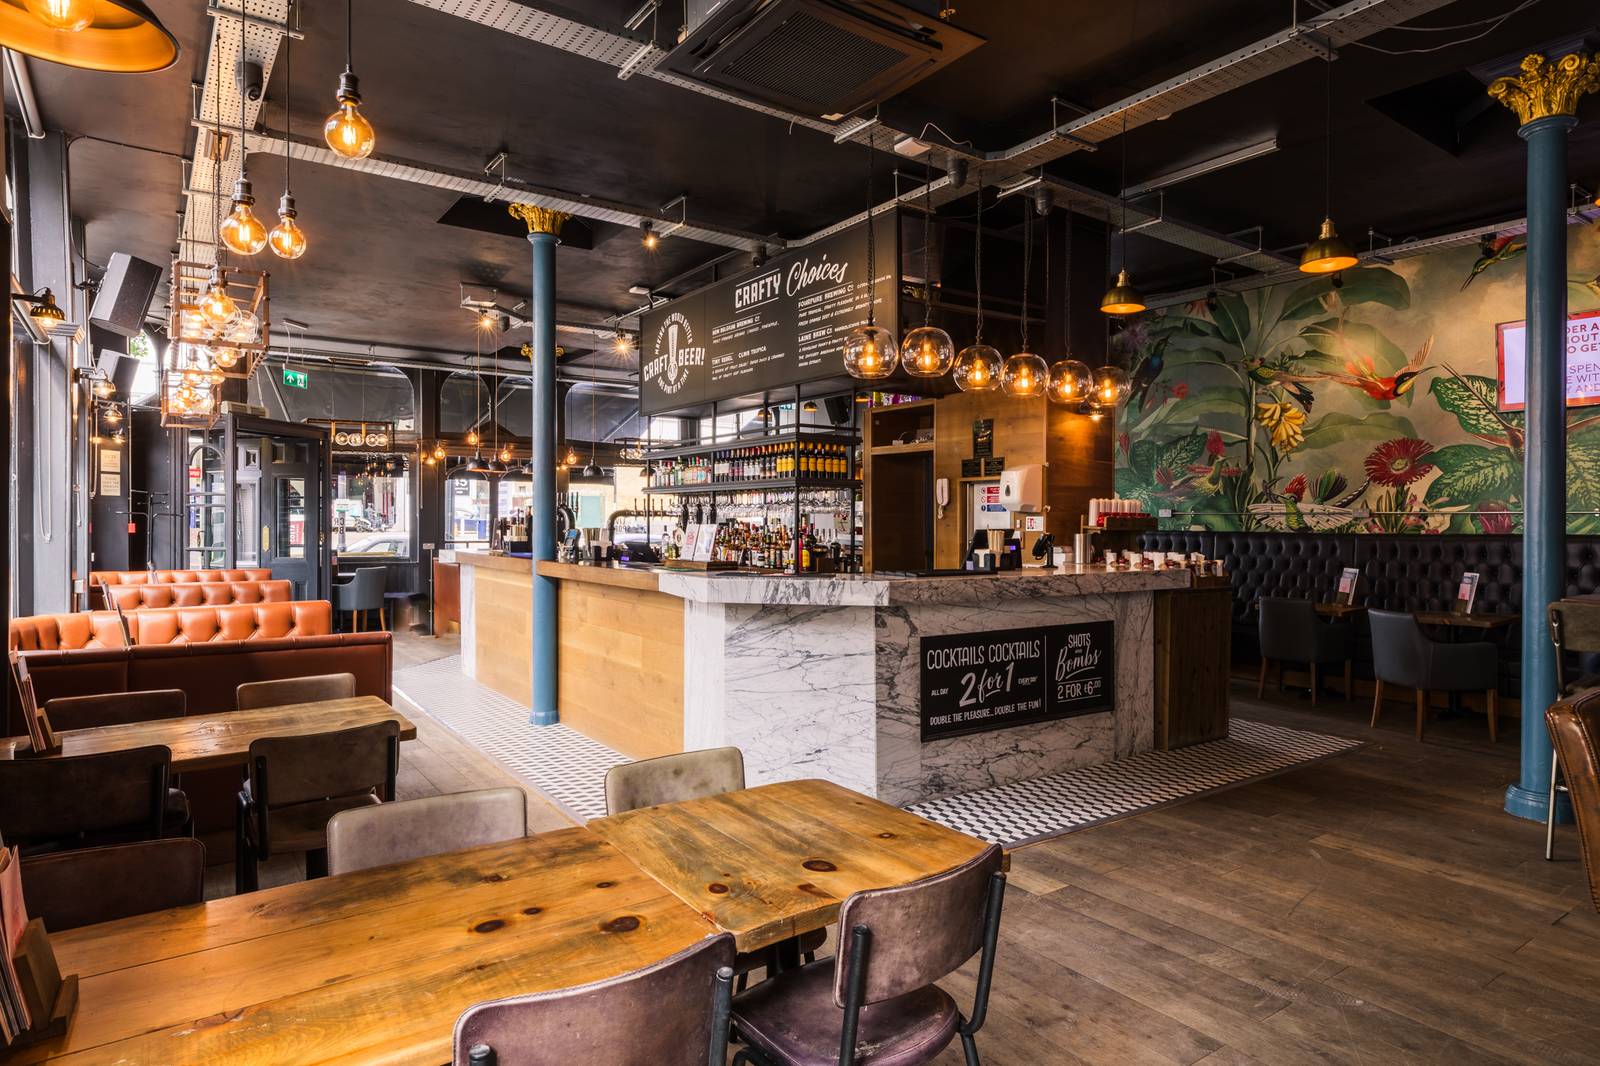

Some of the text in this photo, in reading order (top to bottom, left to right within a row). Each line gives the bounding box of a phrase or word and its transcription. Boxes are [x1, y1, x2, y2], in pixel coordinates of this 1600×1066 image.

[735, 254, 848, 308] CRAFTY Choices
[825, 287, 846, 299] BREWING
[737, 318, 753, 328] BREWING
[1567, 324, 1587, 334] DER
[655, 326, 665, 355] MAKING
[672, 312, 684, 324] WORLD
[683, 319, 693, 345] BETTER
[798, 334, 812, 342] LAINE
[813, 330, 825, 339] BREW
[644, 347, 705, 381] CRAFT BEER!
[1569, 362, 1600, 374] SPEN
[1576, 372, 1600, 383] WIT
[1068, 633, 1091, 648] SHOTS
[927, 640, 1040, 670] COCKTAILS COCKTAILS
[1056, 646, 1102, 681] Bombs
[960, 662, 1015, 707] 2 for 1
[1058, 685, 1064, 699] 2
[1066, 683, 1082, 698] FOR
[930, 714, 952, 726] DOUBLE
[952, 712, 963, 722] THE
[995, 704, 1015, 715] DOUBLE
[1017, 702, 1027, 712] THE
[1029, 698, 1041, 710] FUN!
